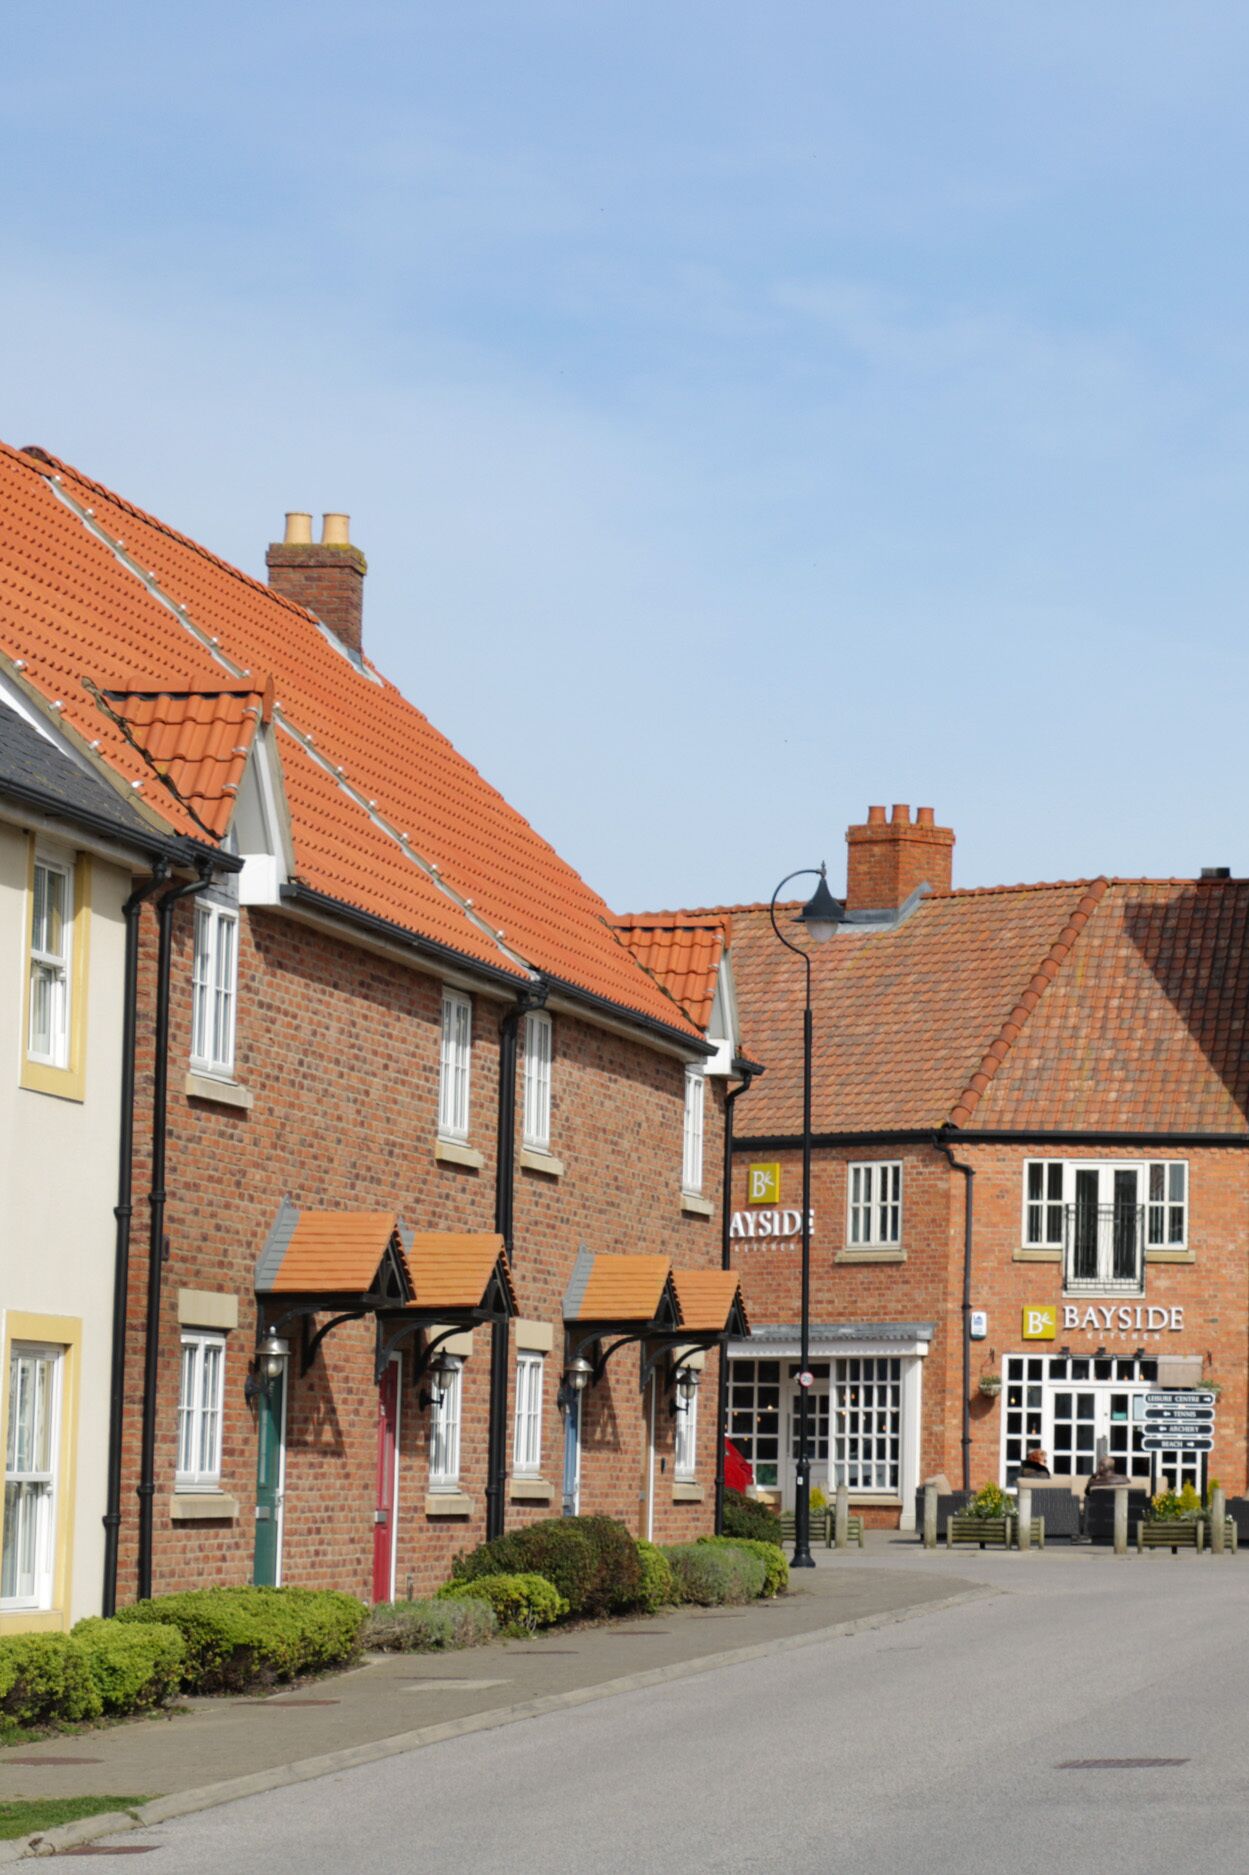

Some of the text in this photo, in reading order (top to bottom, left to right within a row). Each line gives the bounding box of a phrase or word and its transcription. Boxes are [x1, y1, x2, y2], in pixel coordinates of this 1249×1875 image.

[1063, 1305, 1185, 1330] BAYSIDE
[1147, 1395, 1200, 1403] LEISURE CENTRE
